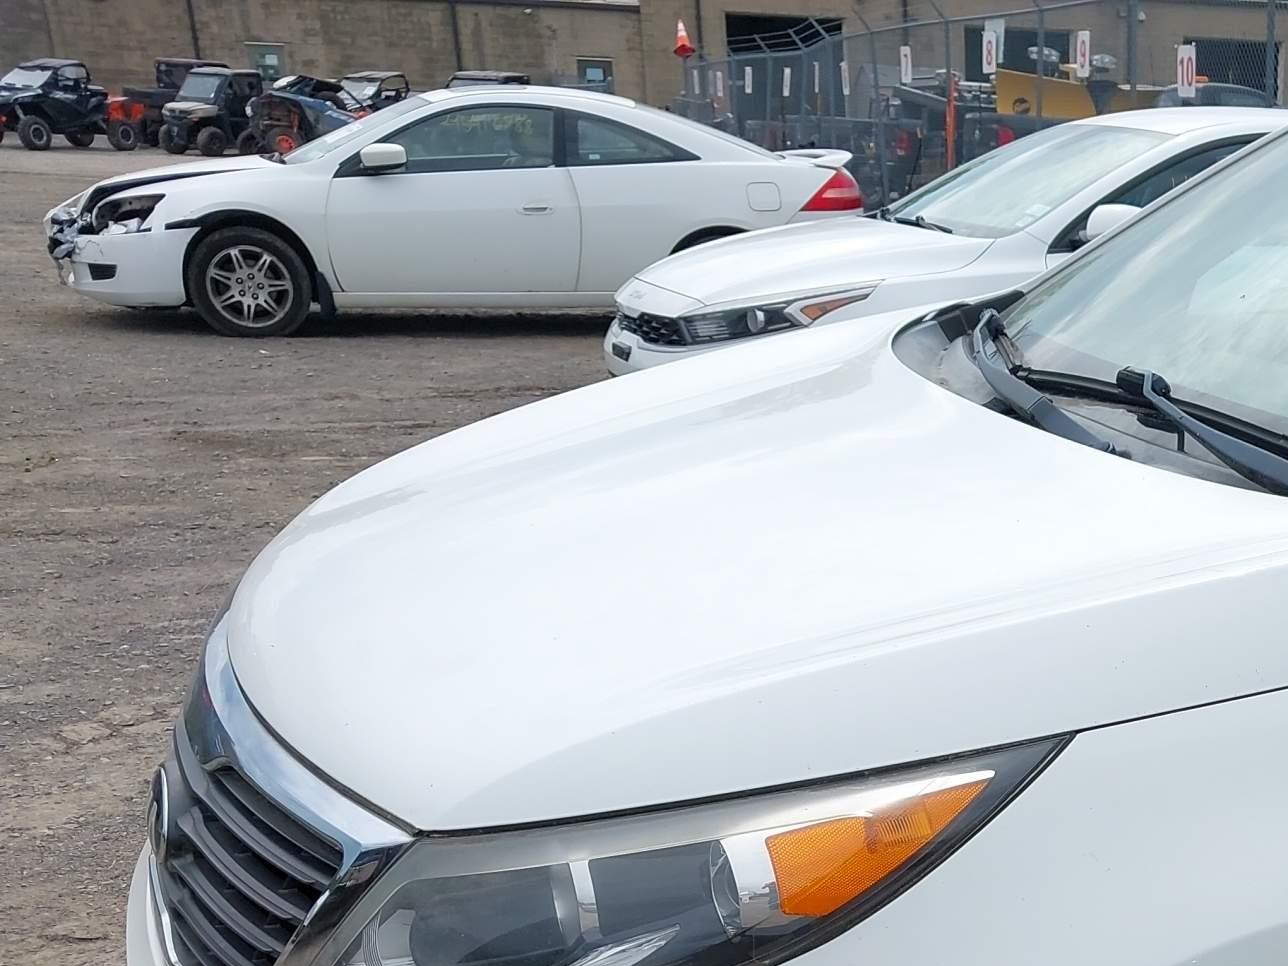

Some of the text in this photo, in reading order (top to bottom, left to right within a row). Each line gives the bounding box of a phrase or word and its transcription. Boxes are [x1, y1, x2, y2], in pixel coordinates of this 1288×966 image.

[985, 39, 994, 67] 8
[1079, 38, 1087, 69] 9
[1178, 55, 1194, 87] 10
